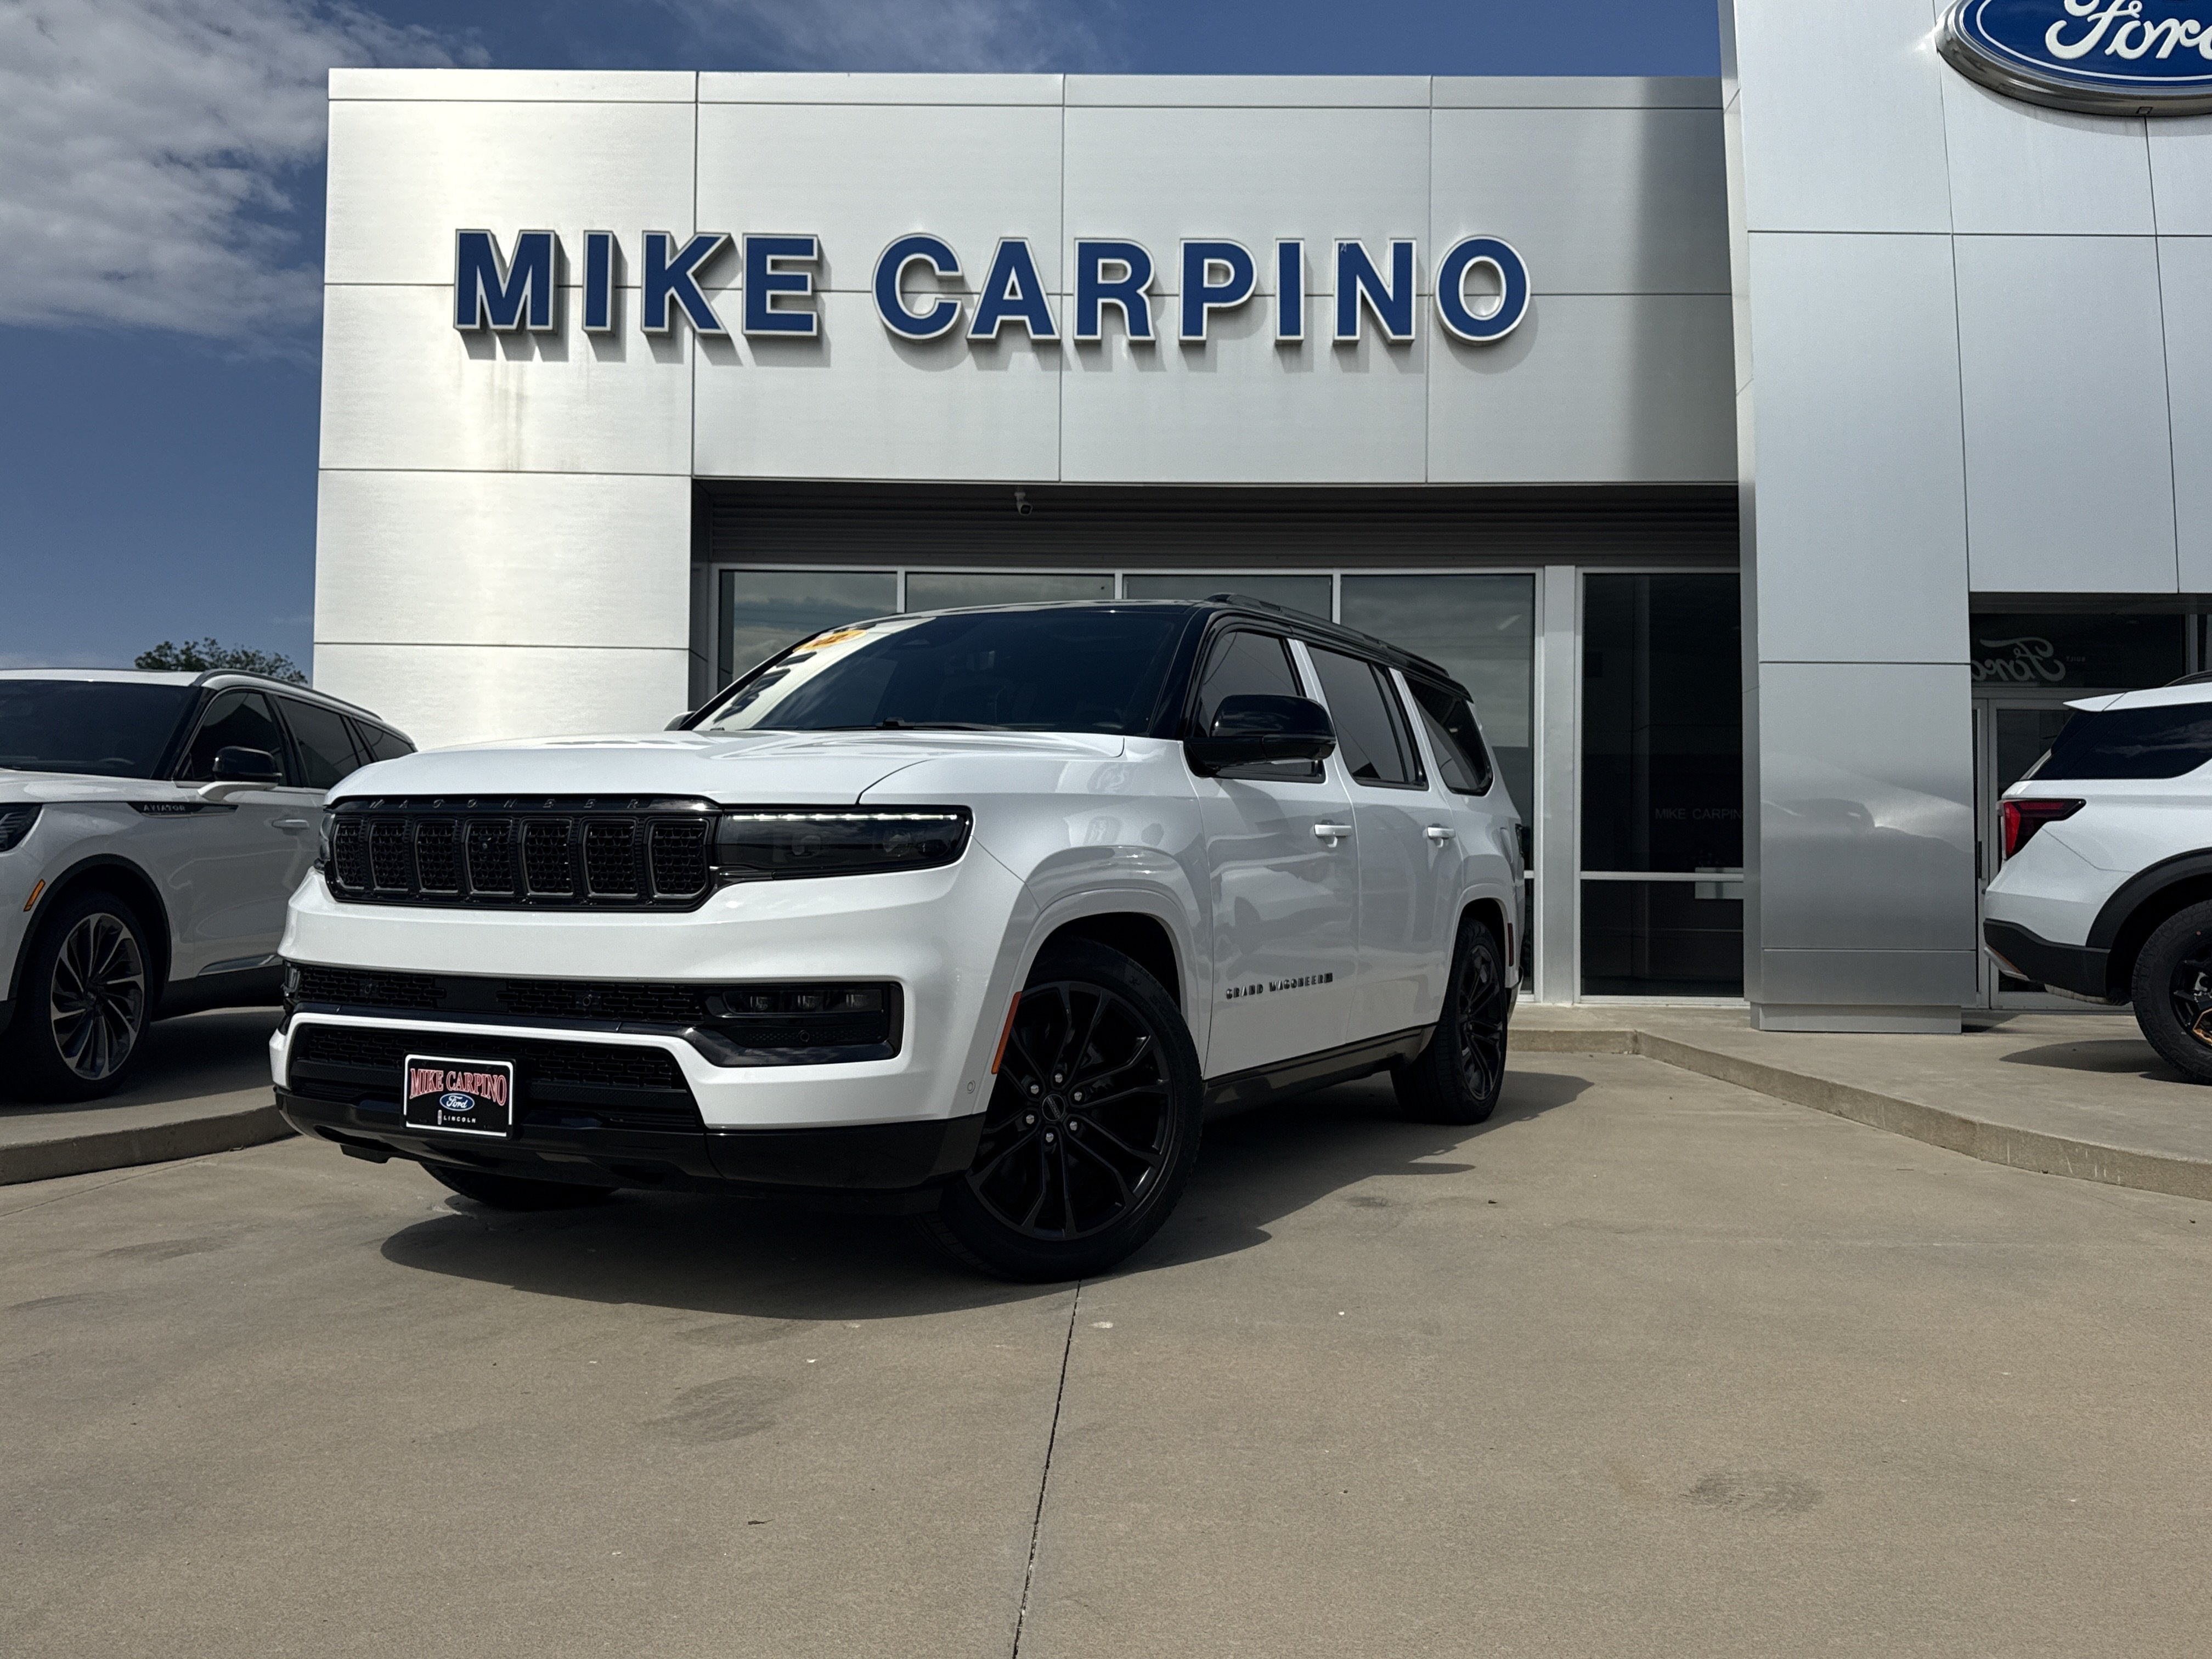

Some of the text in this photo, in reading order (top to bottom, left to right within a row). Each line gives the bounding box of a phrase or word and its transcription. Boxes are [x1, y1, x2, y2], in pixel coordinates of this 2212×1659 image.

[453, 229, 1531, 341] MIKE CARPINO
[143, 804, 185, 812] AVIATOR
[369, 798, 639, 809] WAGONEER
[1656, 809, 1686, 820] MIKE
[1226, 974, 1323, 1000] GRAND WAGONEER
[409, 1068, 507, 1106] MIKE CARPINO
[446, 1096, 468, 1108] Ford
[443, 1115, 476, 1124] LINCOLN
